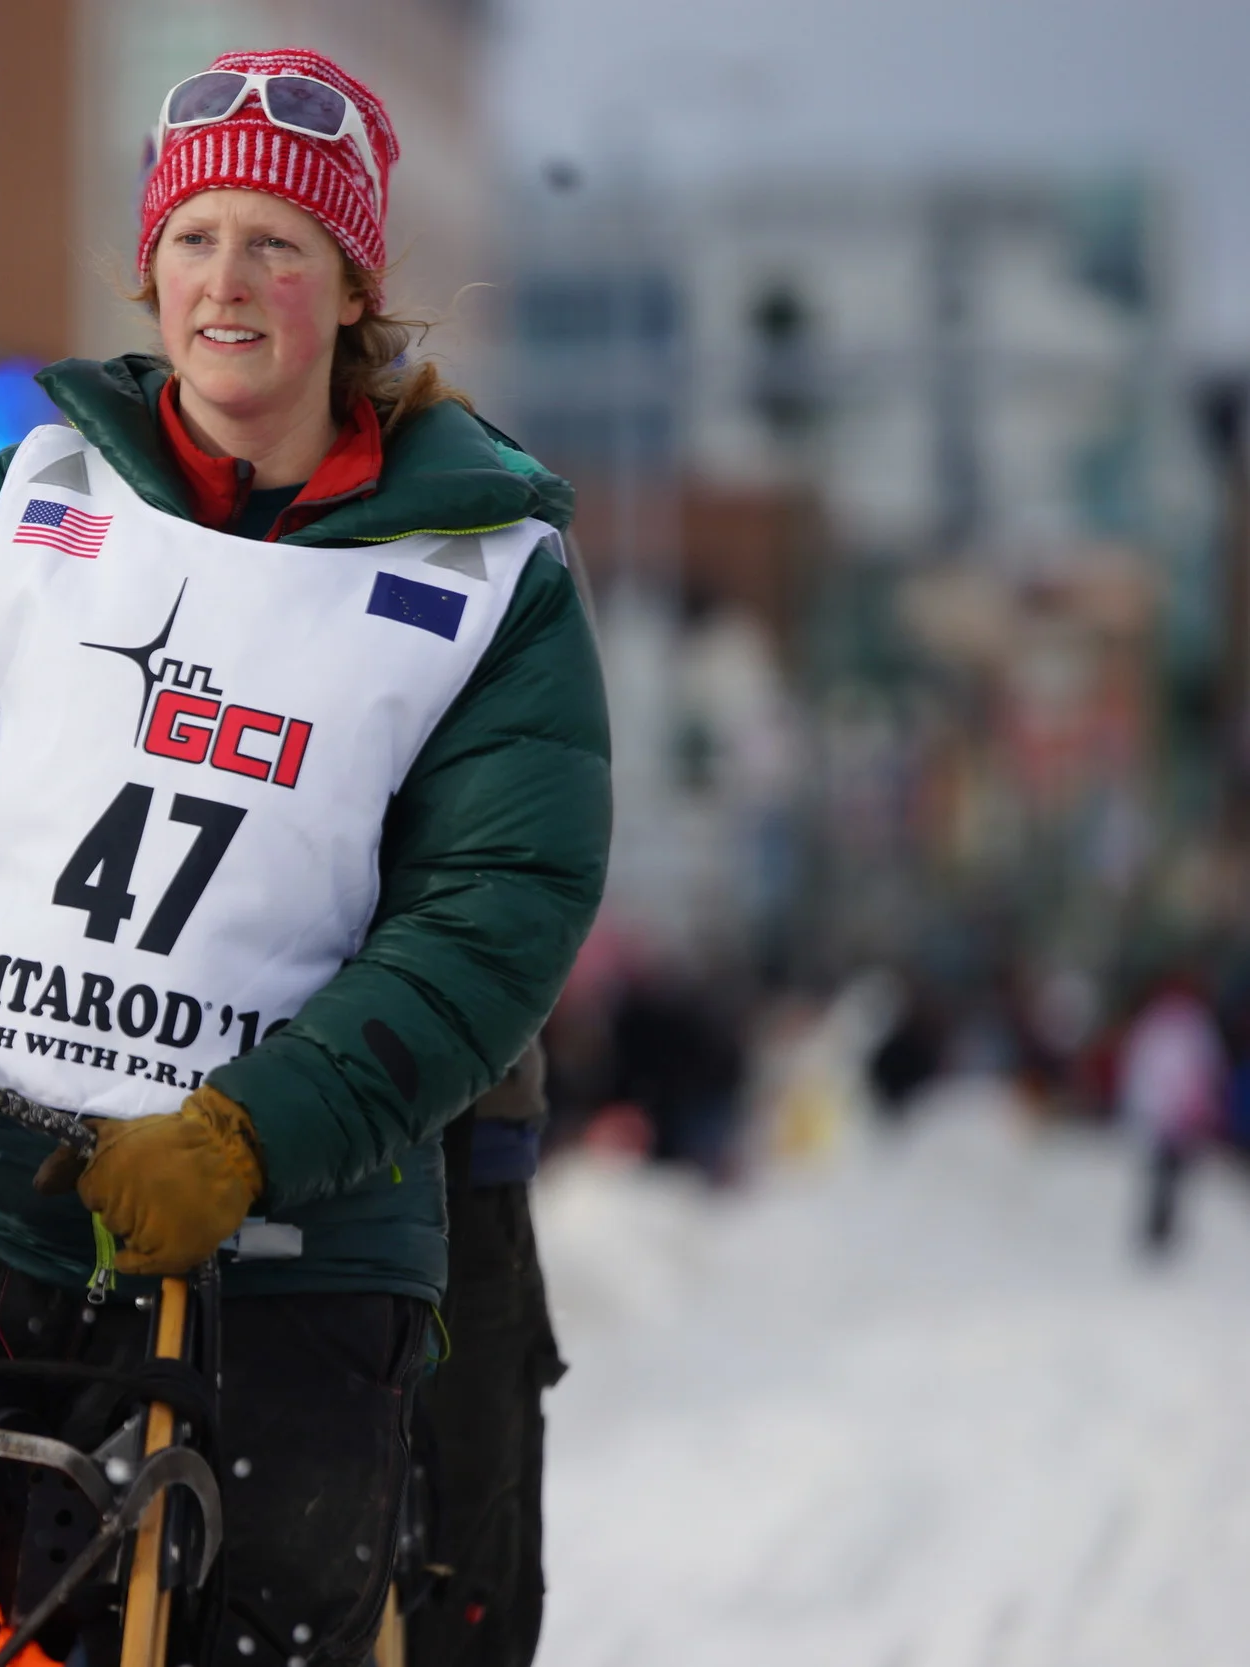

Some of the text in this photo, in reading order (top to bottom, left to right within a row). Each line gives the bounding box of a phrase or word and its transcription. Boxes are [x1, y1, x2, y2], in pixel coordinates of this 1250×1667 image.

[144, 689, 313, 790] GCI
[52, 781, 248, 956] 47
[25, 1031, 119, 1072] WITH
[219, 1004, 293, 1063] '1
